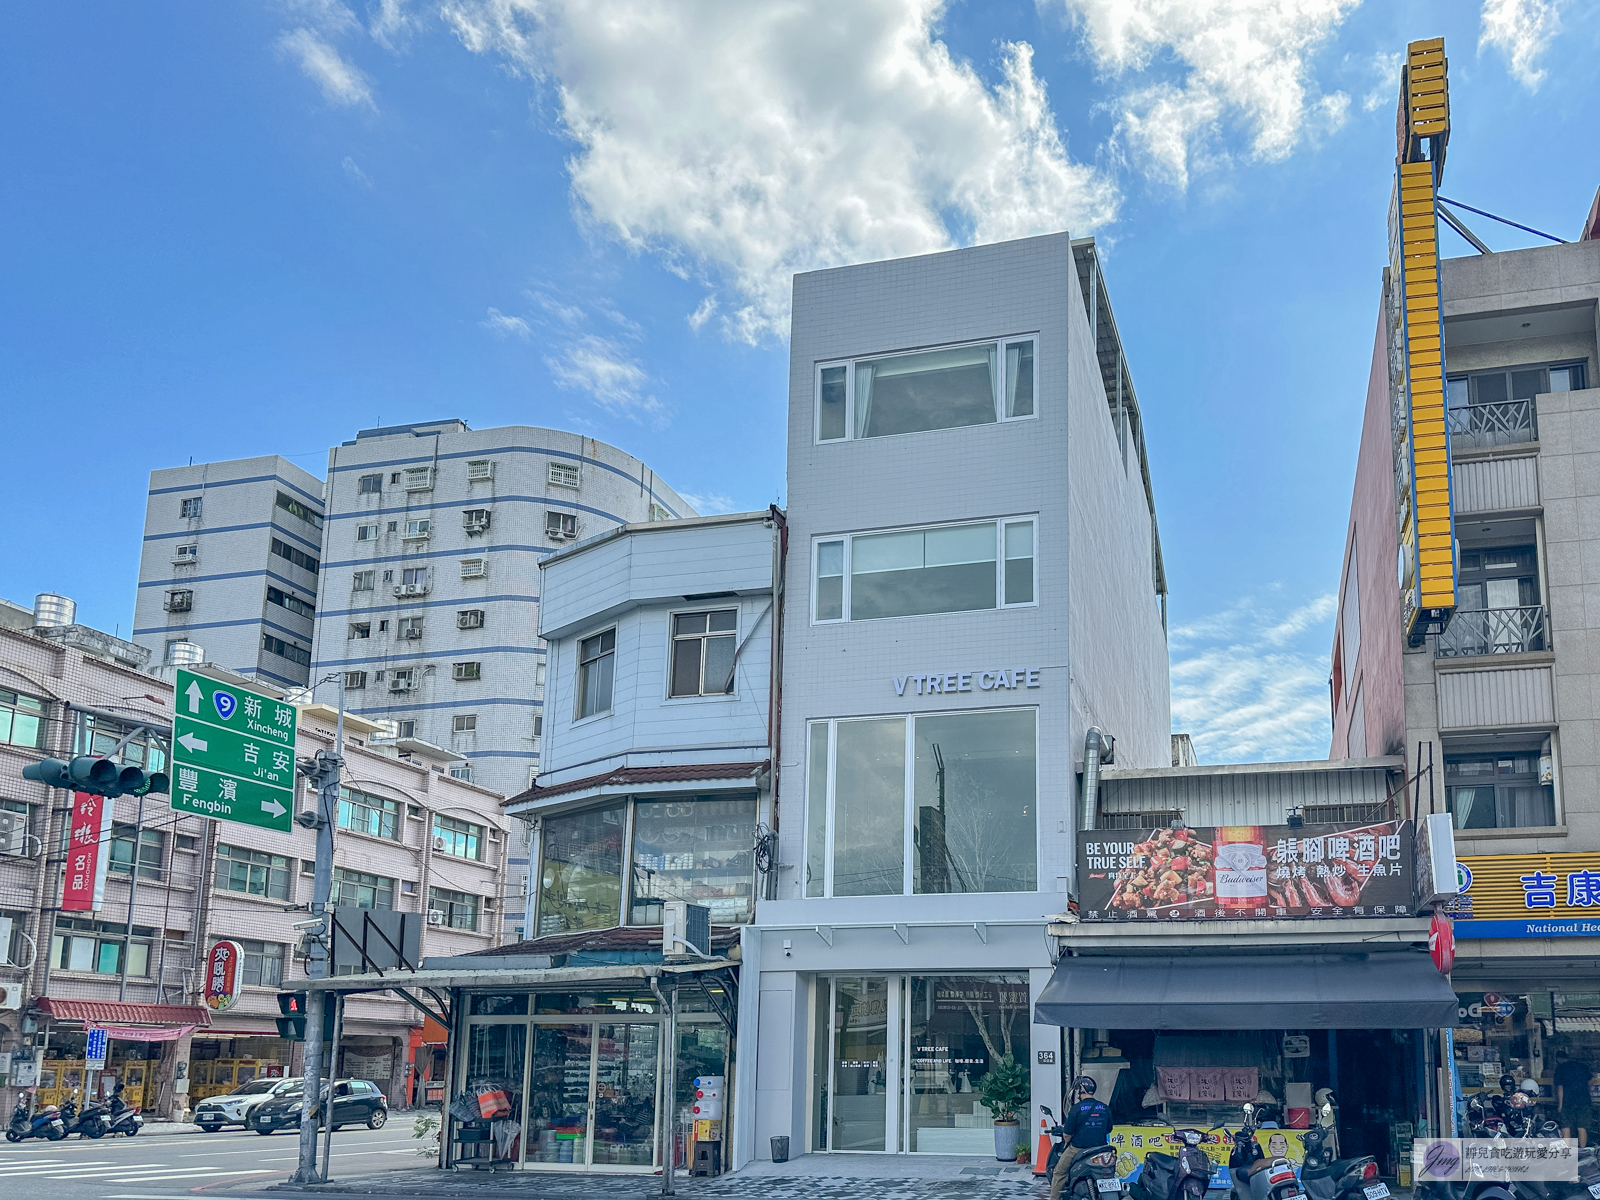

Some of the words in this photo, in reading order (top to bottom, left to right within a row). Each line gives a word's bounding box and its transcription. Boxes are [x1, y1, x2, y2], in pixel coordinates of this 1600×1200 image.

[893, 676, 909, 697] V
[913, 672, 972, 696] TREE
[978, 667, 1040, 691] CAFE
[220, 696, 232, 712] 9
[244, 695, 293, 729] 新城
[247, 718, 289, 742] Xincheng
[243, 742, 290, 773] 吉安
[253, 767, 279, 782] Ji'an
[178, 767, 238, 802] 豐濱
[183, 793, 232, 814] Fengbin
[1085, 842, 1101, 855] BE
[1103, 842, 1135, 855] YOUR
[1086, 856, 1117, 870] TRUE
[1118, 856, 1146, 869] SELF
[1357, 862, 1403, 877] 生魚片
[1219, 873, 1264, 884] Budweiser
[1526, 923, 1578, 933] National
[1038, 1051, 1054, 1060] 364
[1112, 1132, 1164, 1149] 啤酒吧
